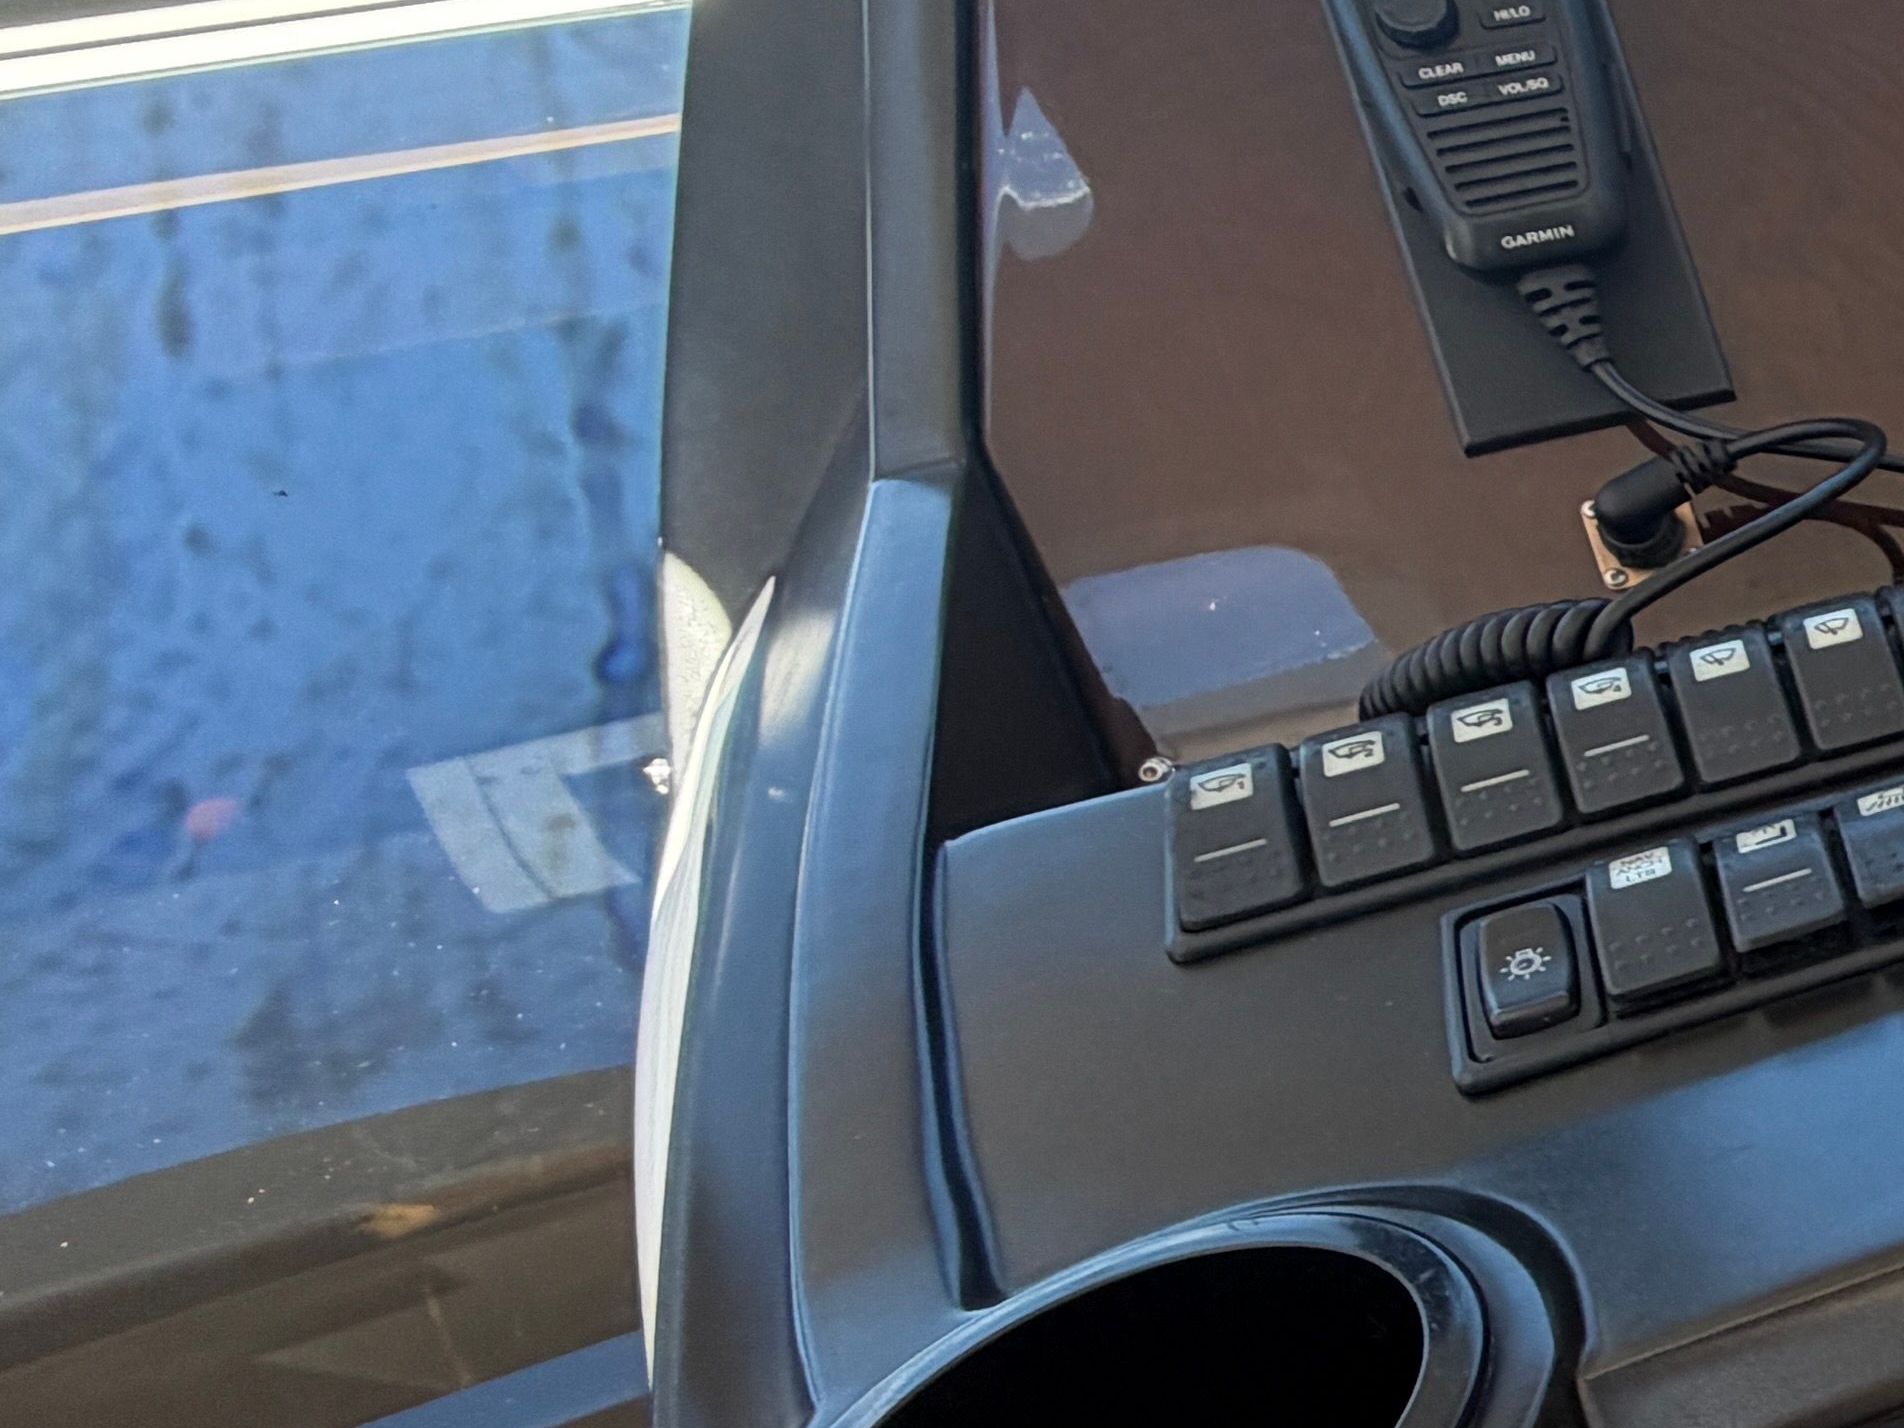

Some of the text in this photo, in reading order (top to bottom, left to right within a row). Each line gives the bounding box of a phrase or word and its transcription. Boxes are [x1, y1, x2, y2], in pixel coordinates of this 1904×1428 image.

[1495, 50, 1536, 66] MENU
[1418, 62, 1464, 79] CLEAR
[1498, 76, 1549, 96] VOL/SQ
[1437, 91, 1468, 107] DSC
[1501, 225, 1575, 249] GARMIN
